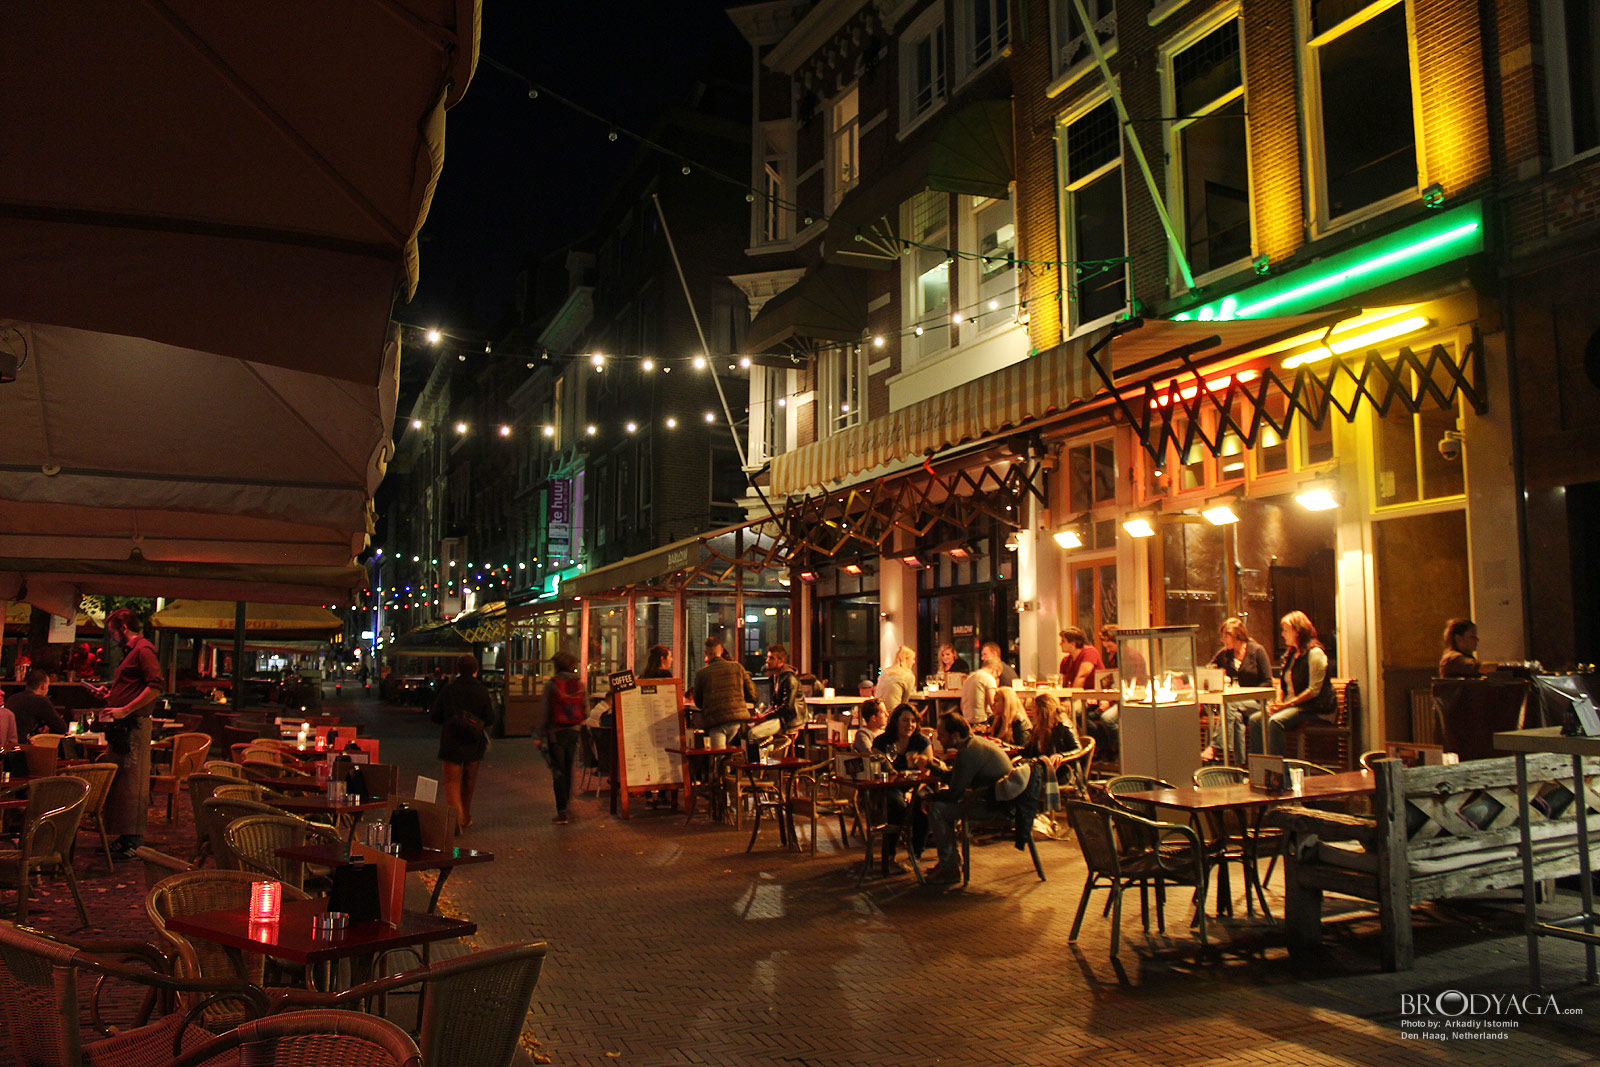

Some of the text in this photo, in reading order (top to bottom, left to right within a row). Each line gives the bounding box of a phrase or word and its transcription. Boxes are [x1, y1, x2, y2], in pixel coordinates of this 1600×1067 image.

[551, 480, 563, 509] huur
[219, 619, 279, 628] LEPOLD
[611, 674, 632, 686] COFFEE
